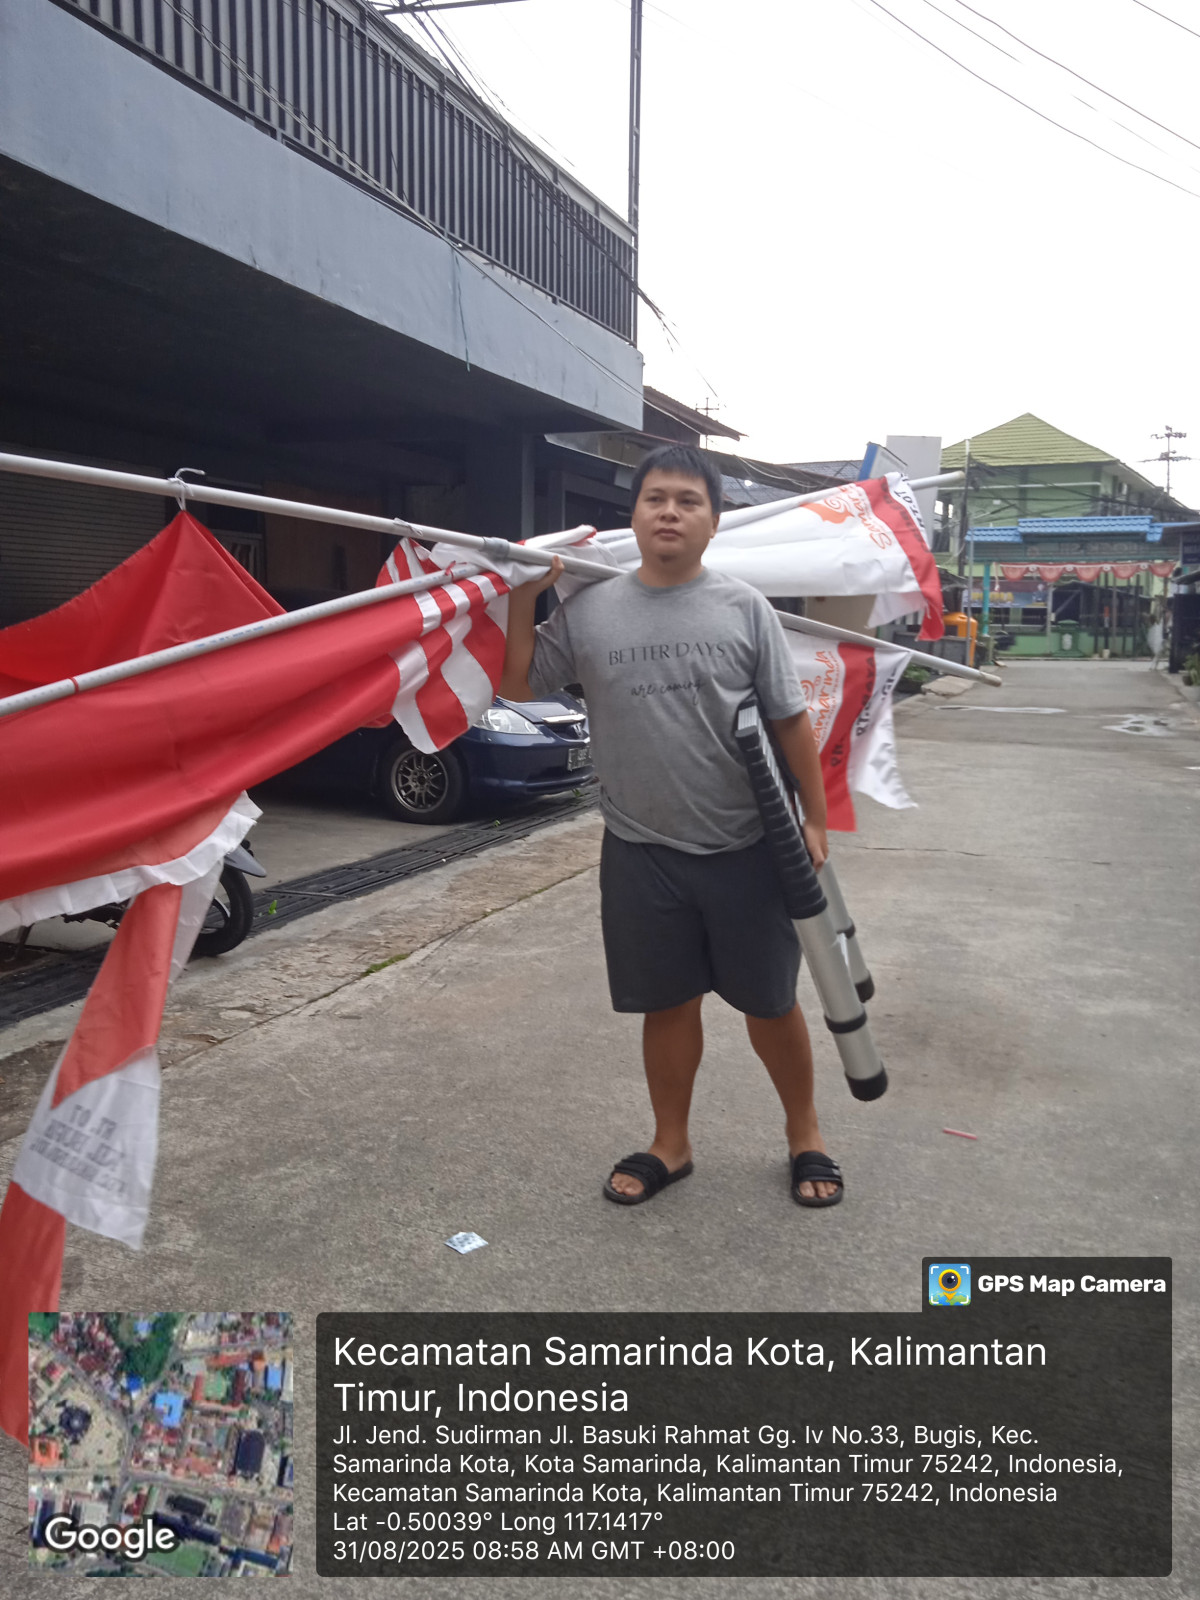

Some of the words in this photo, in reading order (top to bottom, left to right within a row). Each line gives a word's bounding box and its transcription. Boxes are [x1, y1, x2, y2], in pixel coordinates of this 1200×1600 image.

[608, 644, 670, 666] BETTER
[676, 641, 726, 658] DAYS
[630, 683, 656, 697] are
[660, 680, 703, 706] coming
[813, 650, 836, 746] amarinda
